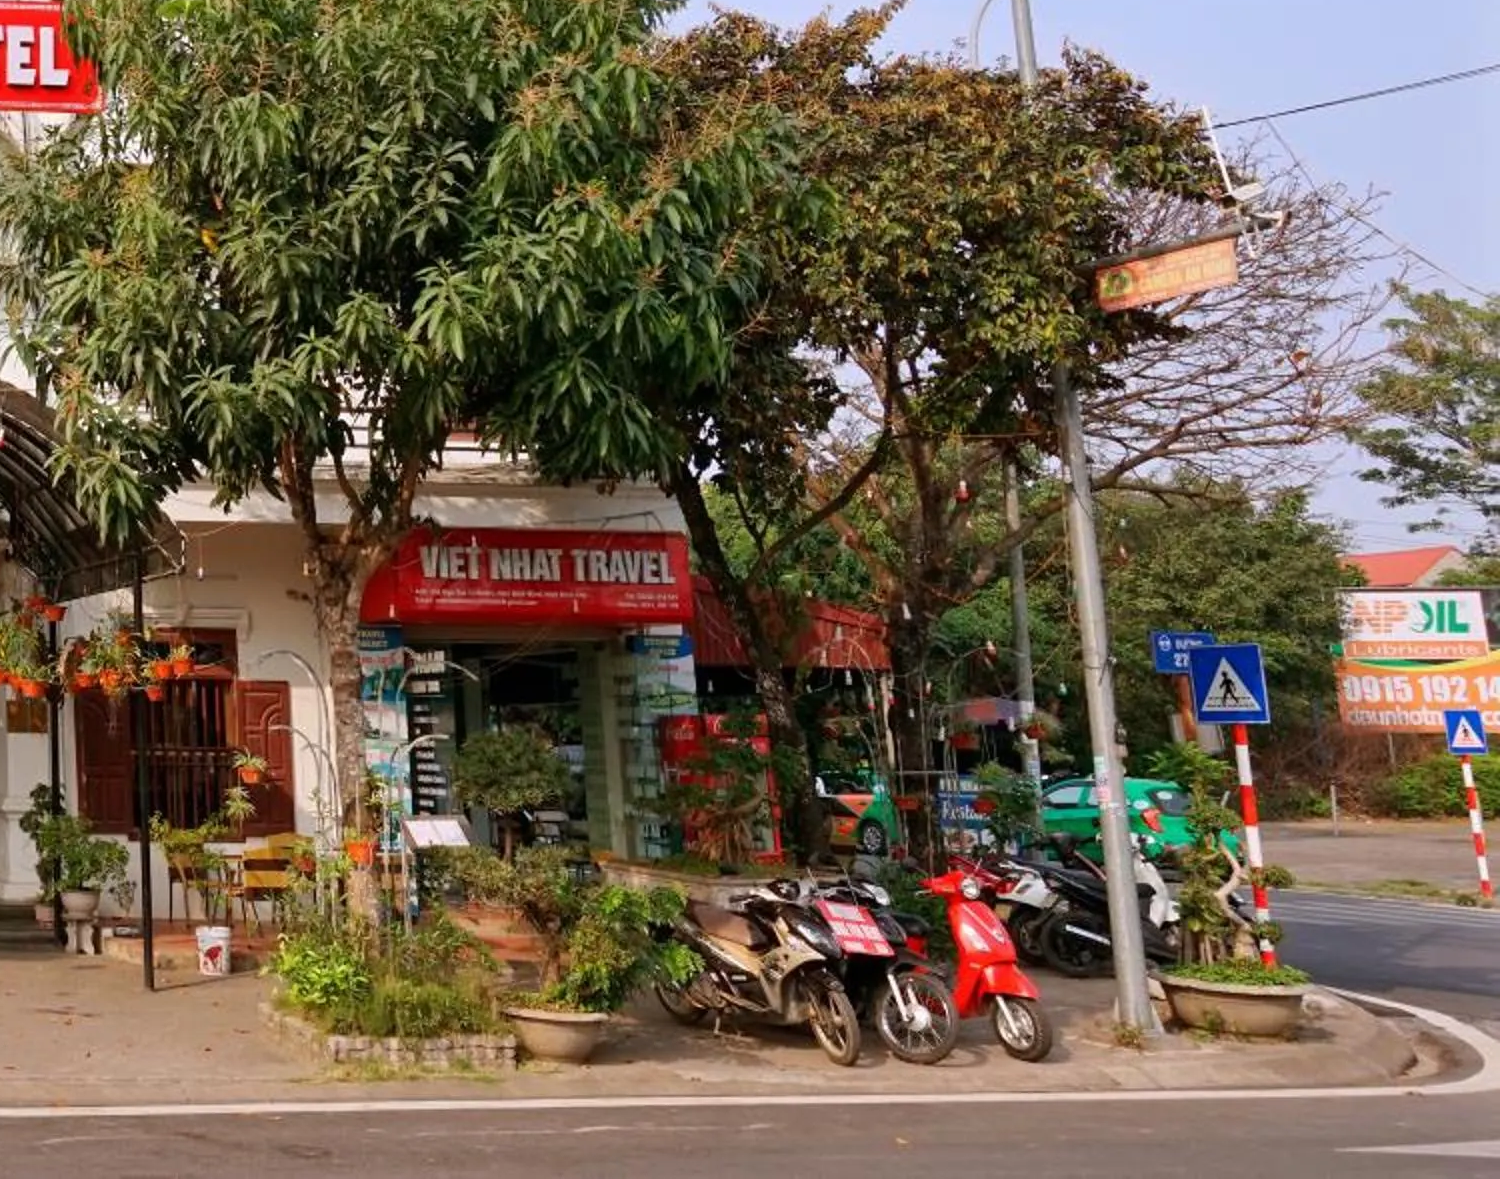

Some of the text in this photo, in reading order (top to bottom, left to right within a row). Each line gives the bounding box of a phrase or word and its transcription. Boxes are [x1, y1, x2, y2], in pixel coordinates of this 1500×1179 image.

[419, 545, 677, 584] VIET NHAT TRAVEL
[1352, 643, 1480, 657] Lubricants
[1344, 675, 1414, 703] 0915
[1418, 675, 1469, 703] 192
